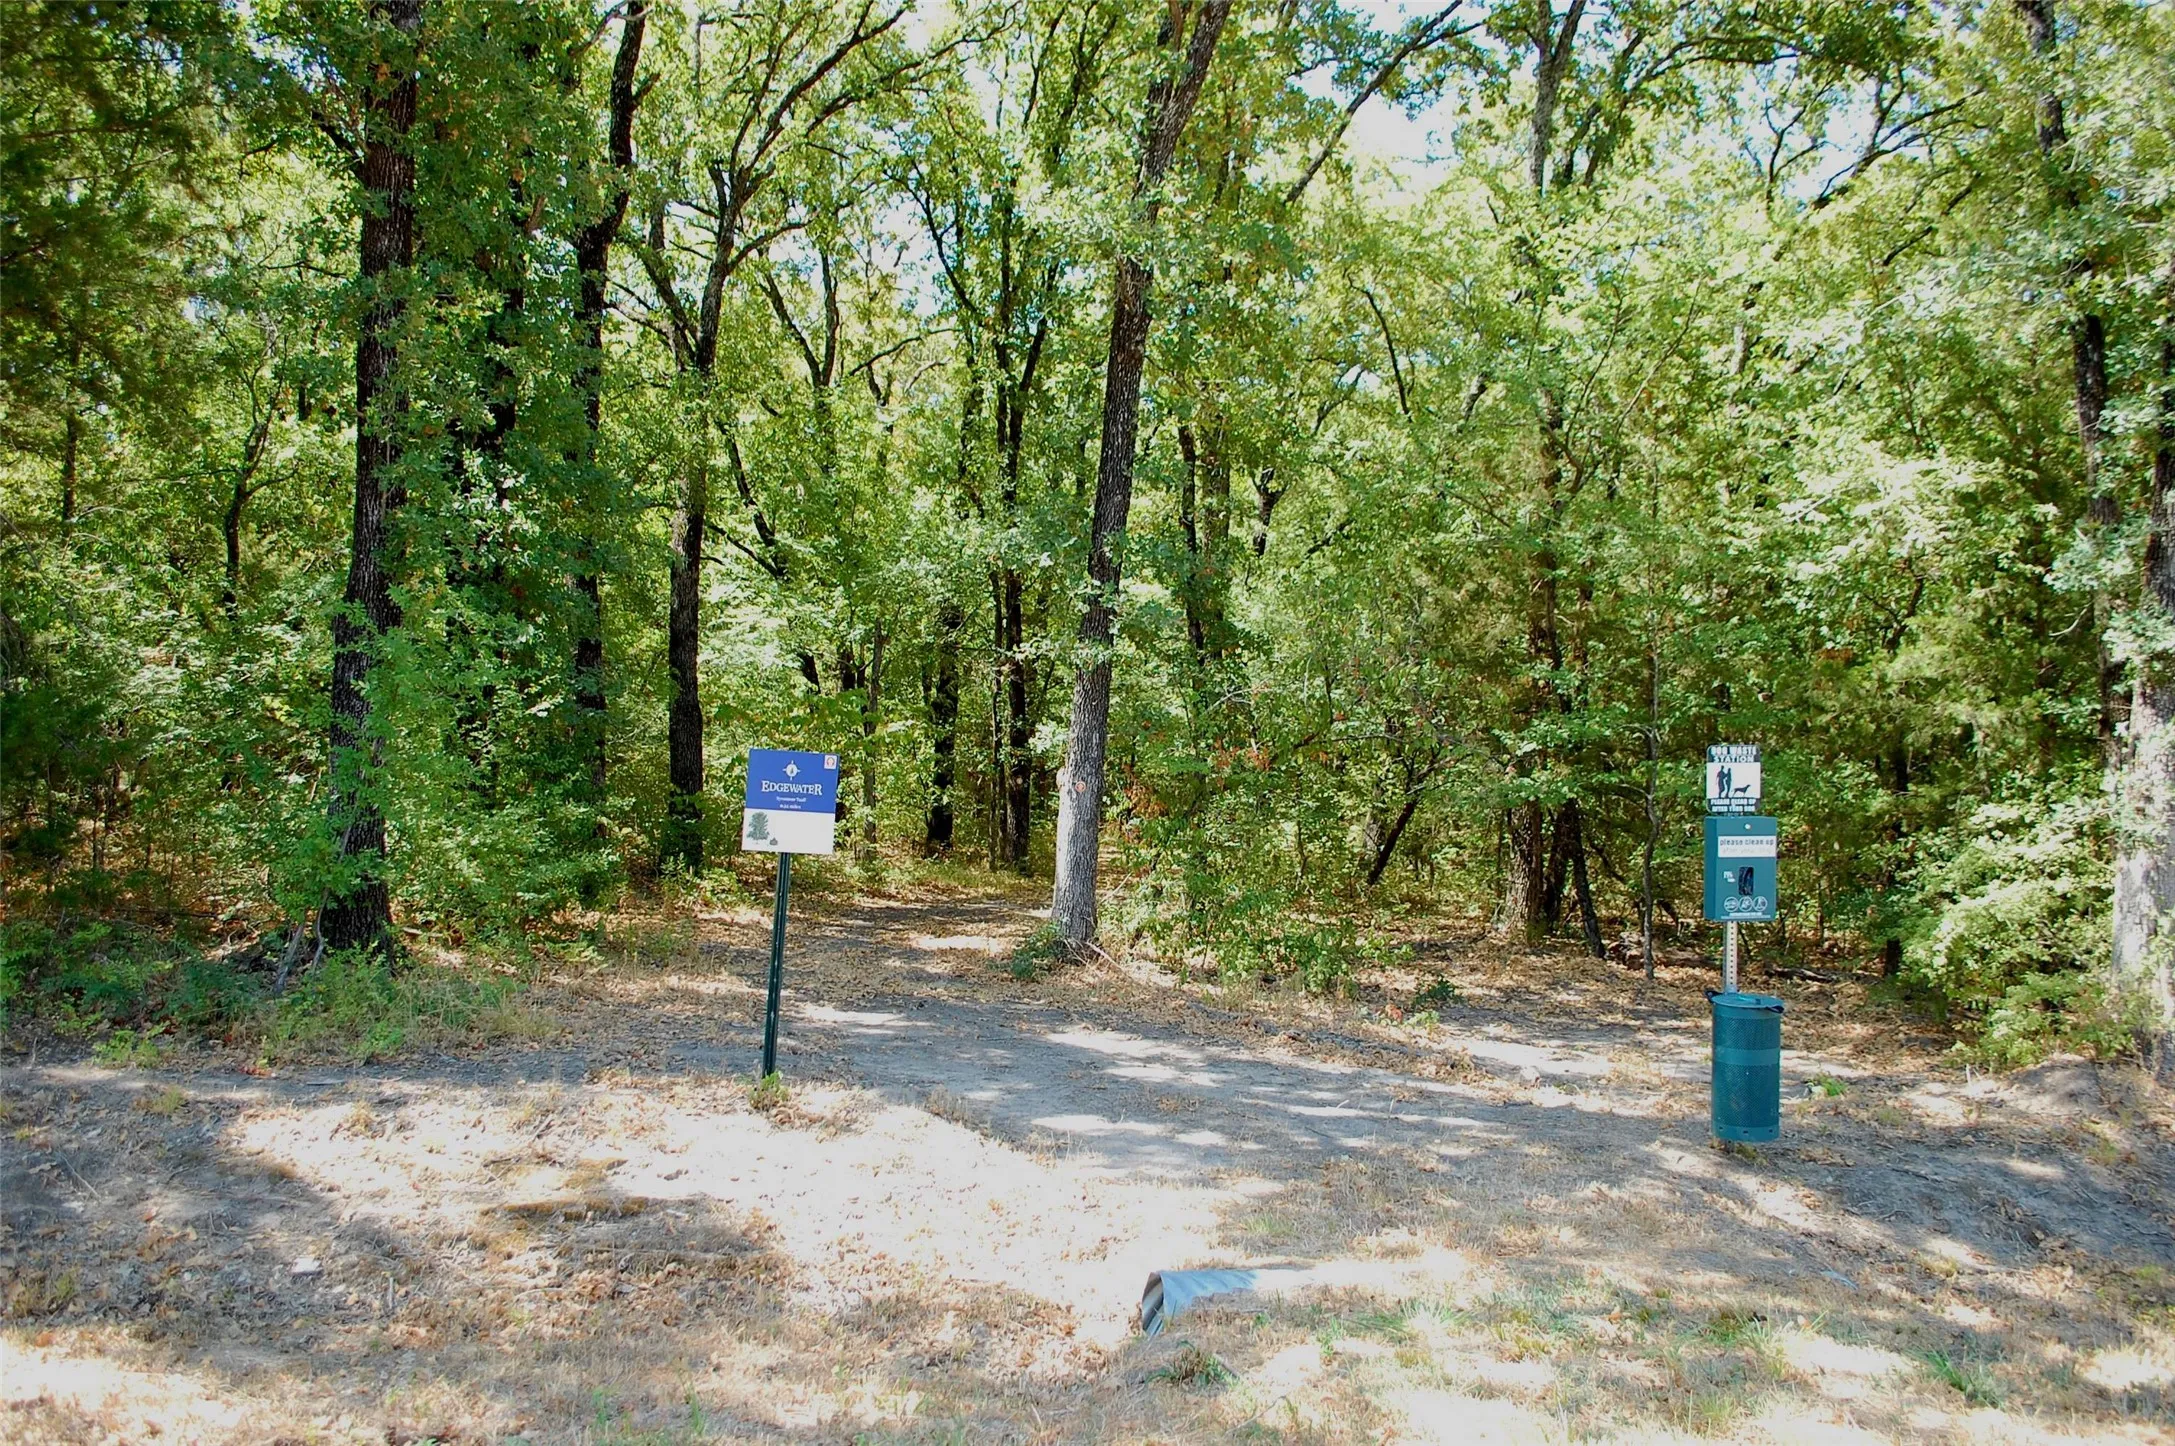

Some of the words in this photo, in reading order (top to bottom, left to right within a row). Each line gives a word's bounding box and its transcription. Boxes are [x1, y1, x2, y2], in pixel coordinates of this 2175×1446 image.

[1729, 746, 1757, 755] WASTE
[1713, 755, 1754, 763] STATION
[761, 780, 823, 796] EDGEWATER
[1719, 838, 1743, 846] please
[1744, 838, 1764, 846] clean
